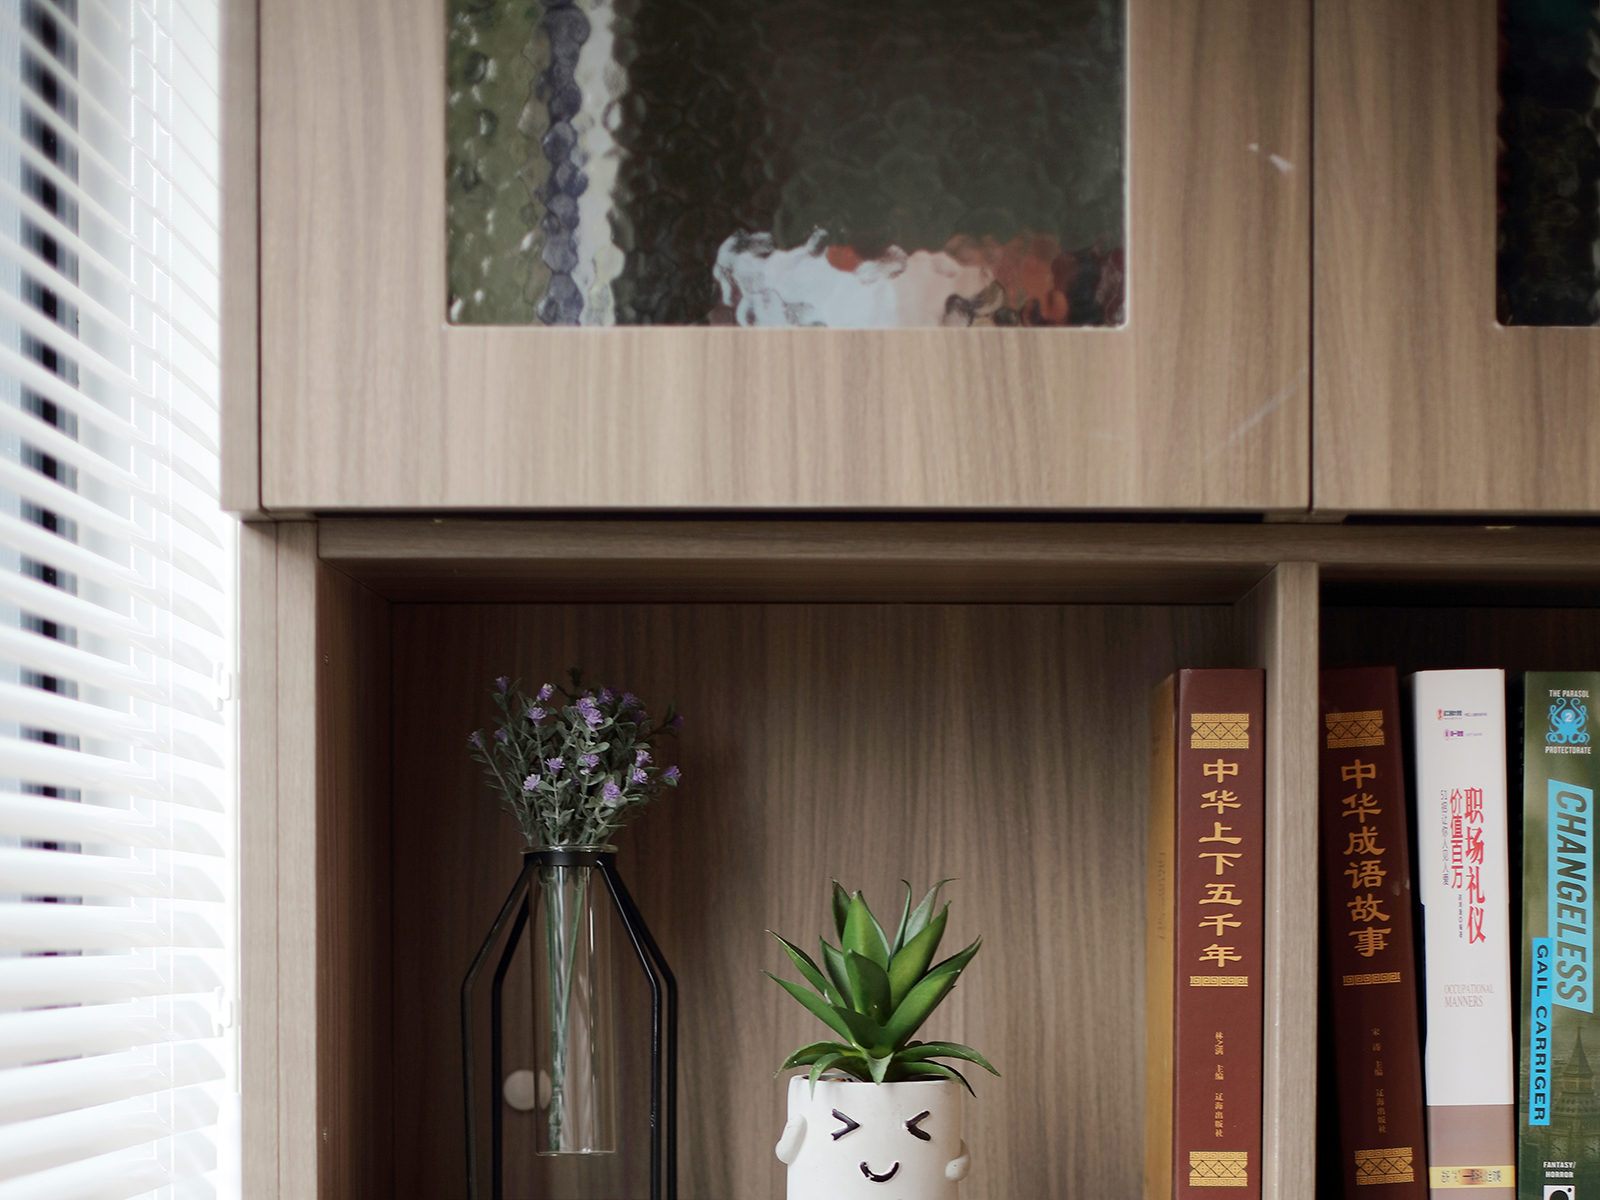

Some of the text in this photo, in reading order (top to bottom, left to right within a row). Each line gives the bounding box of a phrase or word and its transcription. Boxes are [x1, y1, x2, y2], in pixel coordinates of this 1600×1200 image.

[1562, 690, 1589, 698] PARASOL
[1565, 712, 1573, 722] 2
[1545, 746, 1591, 754] PROTECTORATE
[1199, 758, 1242, 968] 中华上下五千年
[1341, 758, 1391, 957] 中华成语故事
[1450, 788, 1464, 889] 价值百万
[1464, 786, 1486, 944] 职场礼仪
[1556, 790, 1587, 1003] CHANGELESS
[1444, 984, 1494, 994] OCCUPATIONAL
[1444, 995, 1484, 1007] MANNERS
[1534, 944, 1549, 1120] GAIL CARRIGER
[1543, 1161, 1577, 1169] FANTASY/
